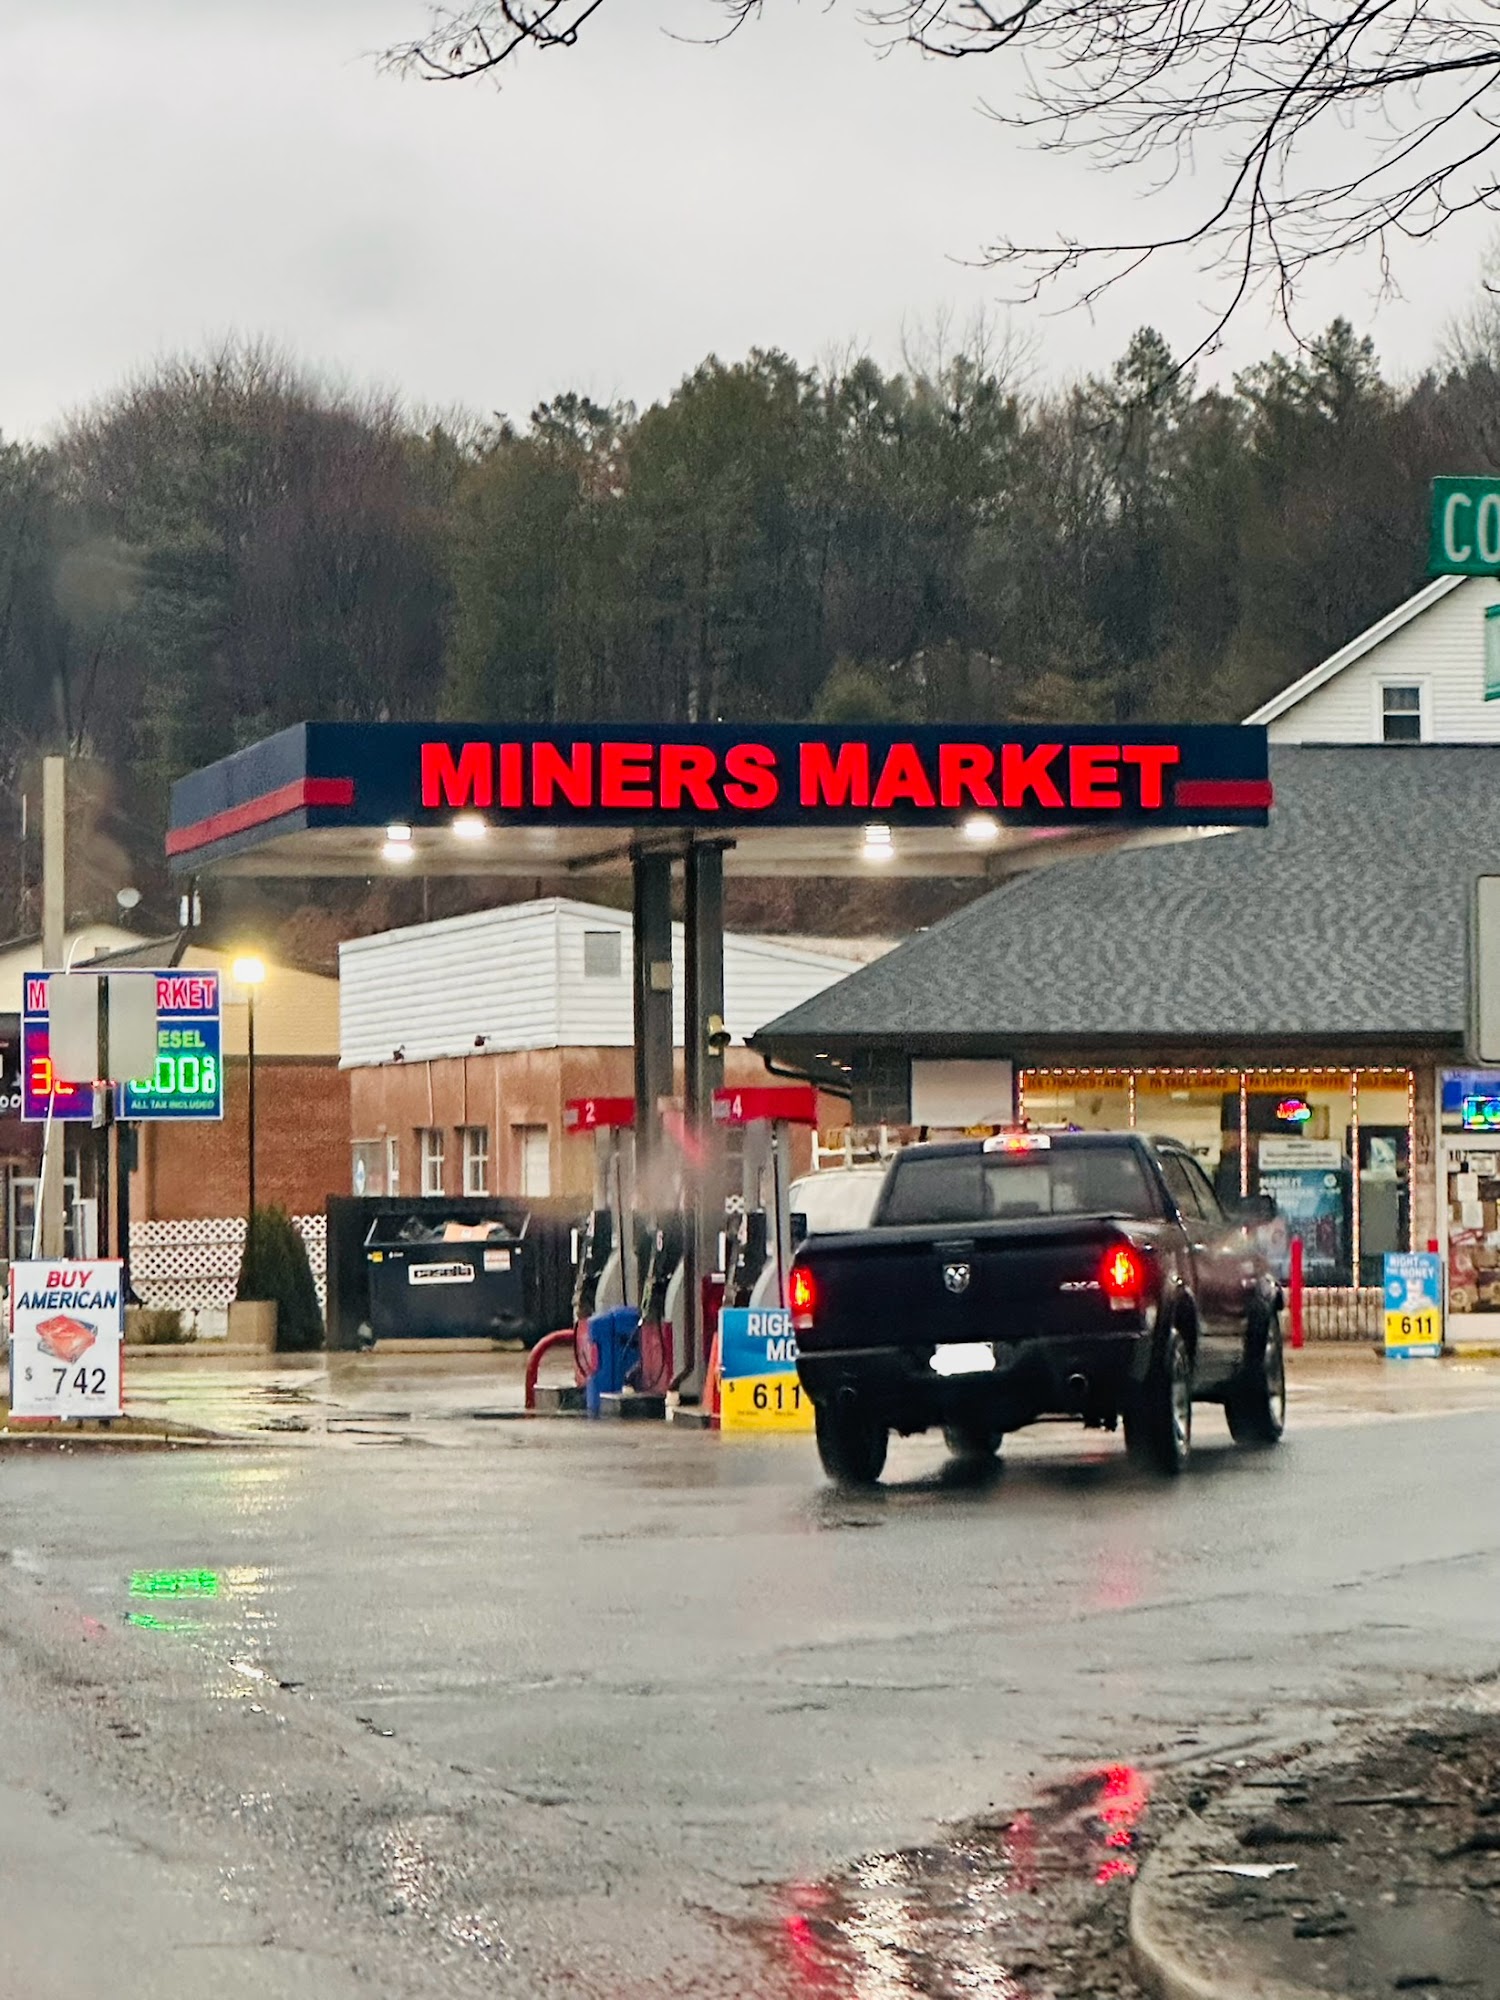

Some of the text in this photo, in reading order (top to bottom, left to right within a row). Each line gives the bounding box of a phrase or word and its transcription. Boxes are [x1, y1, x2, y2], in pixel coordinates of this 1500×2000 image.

[1444, 493, 1500, 563] CO
[421, 742, 1179, 809] MINERS MARKET
[158, 1030, 205, 1048] ESEL
[131, 1100, 148, 1109] ALL
[151, 1100, 167, 1109] TAX
[586, 1102, 595, 1122] 2
[732, 1095, 742, 1118] 4
[1389, 1256, 1419, 1267] RIGHT
[46, 1271, 93, 1288] BUY
[17, 1291, 118, 1310] AMERICAN
[25, 1367, 33, 1381] $
